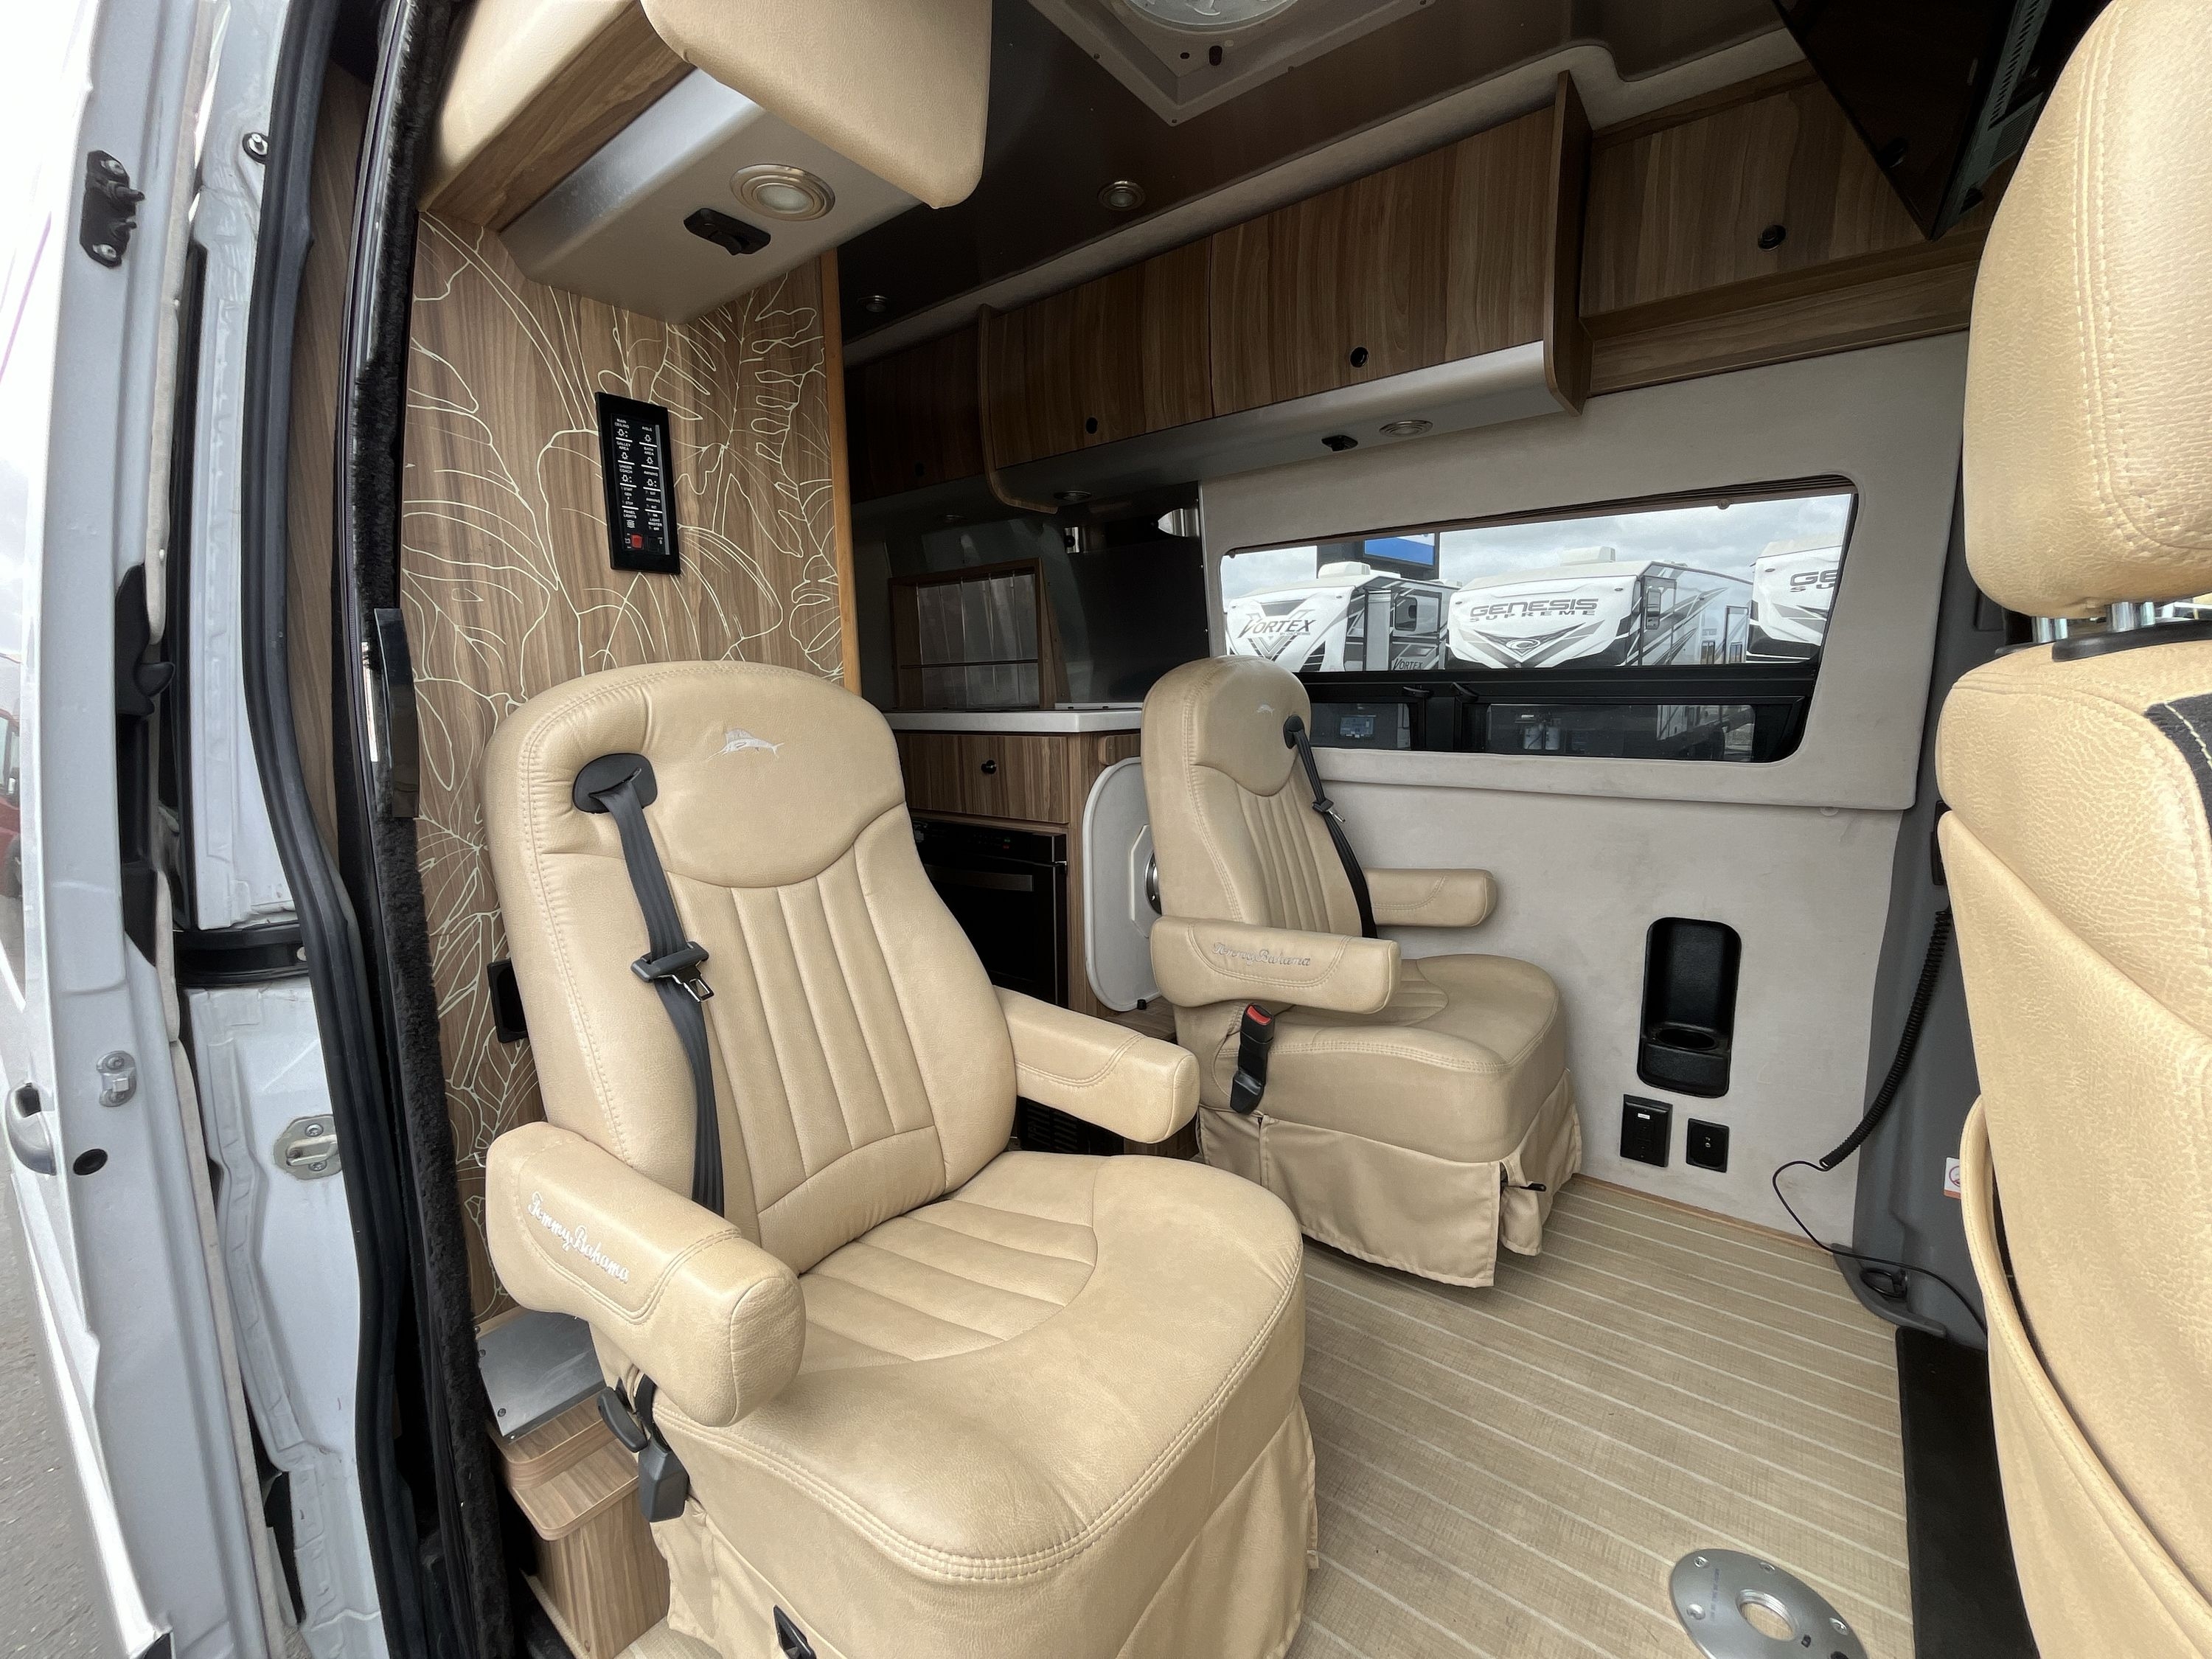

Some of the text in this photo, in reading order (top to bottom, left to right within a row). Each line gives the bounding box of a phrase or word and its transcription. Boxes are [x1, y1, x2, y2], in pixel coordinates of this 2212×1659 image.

[1470, 598, 1599, 617] GENESIS
[1470, 610, 1596, 622] SUPREME
[1237, 613, 1316, 639] VORTEX
[1393, 658, 1423, 670] VORTEX
[1212, 942, 1311, 967] Tommy Bahama
[528, 1191, 630, 1284] Tommy Bahama
